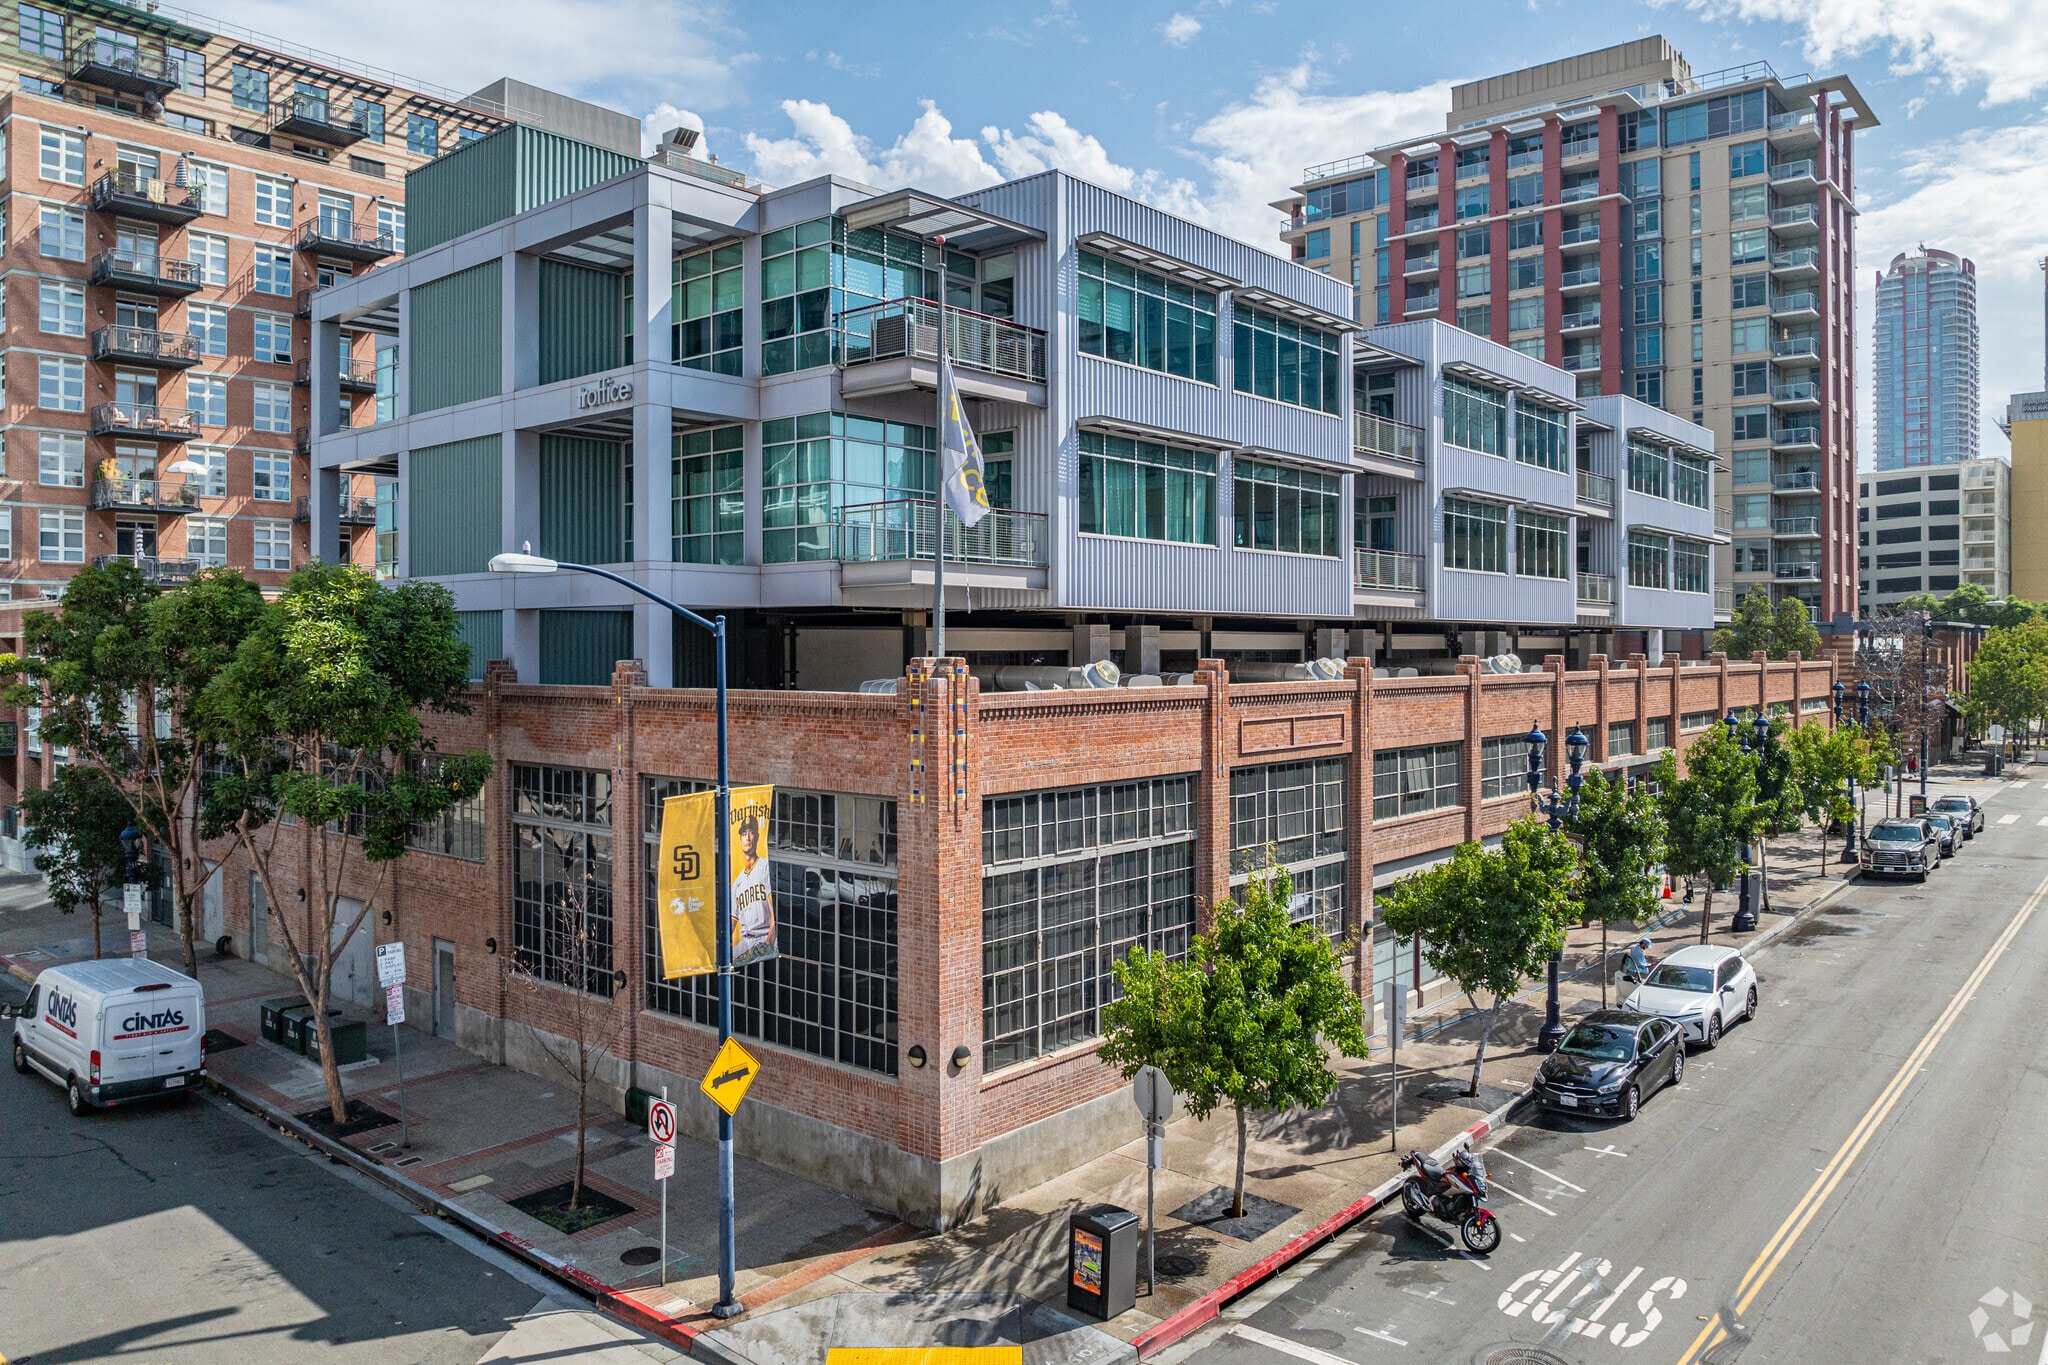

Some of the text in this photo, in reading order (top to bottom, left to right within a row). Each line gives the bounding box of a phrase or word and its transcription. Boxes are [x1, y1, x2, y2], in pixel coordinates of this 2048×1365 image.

[673, 844, 701, 881] SD
[48, 985, 77, 1028] CINTAS
[122, 1007, 184, 1032] CINTAS
